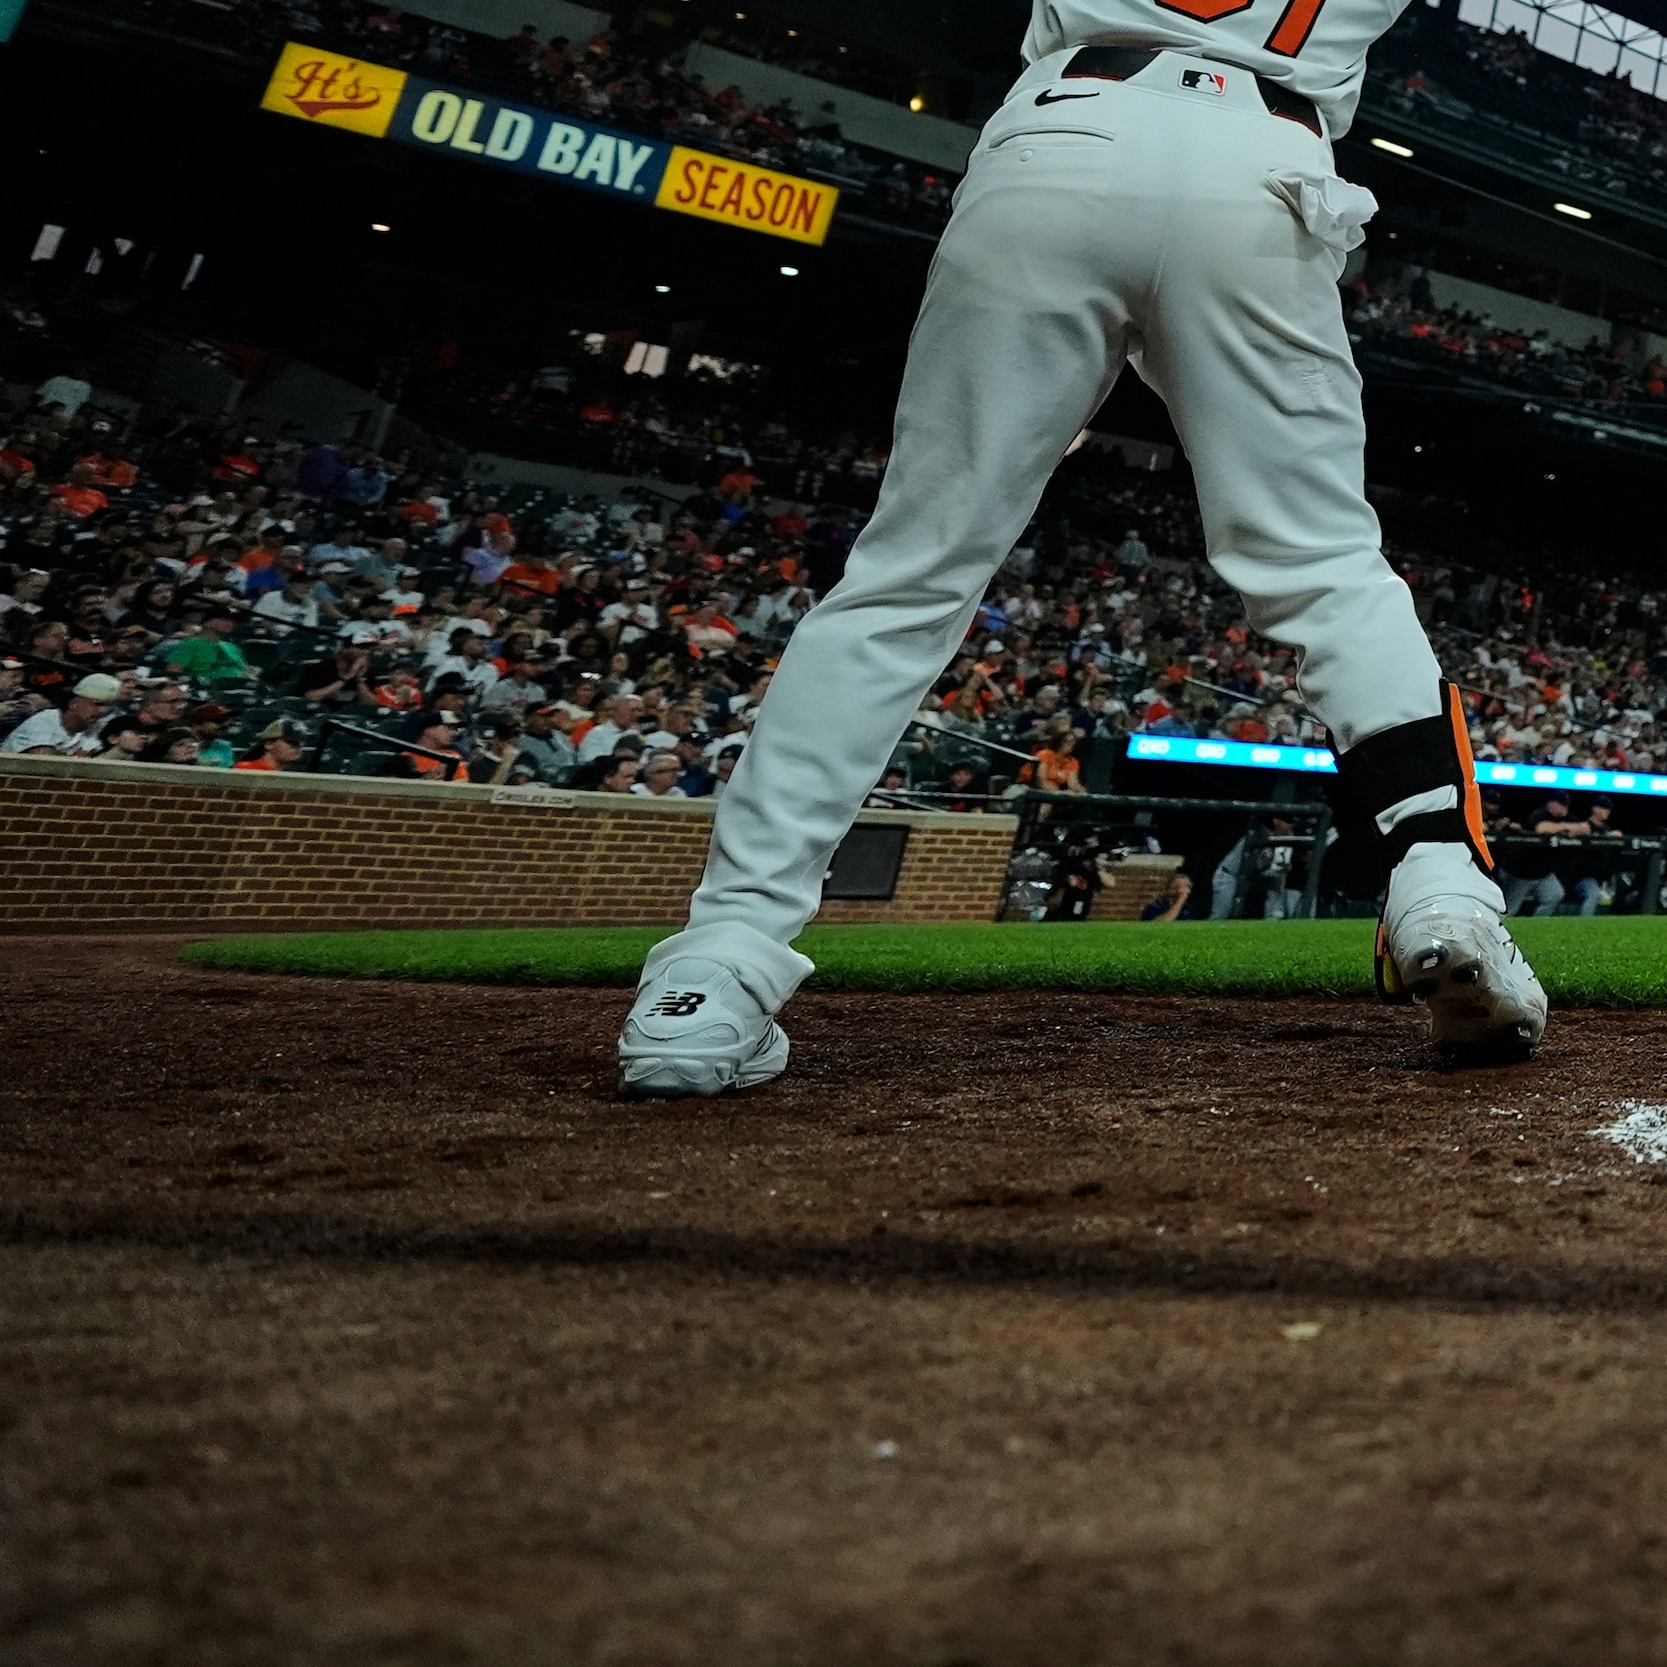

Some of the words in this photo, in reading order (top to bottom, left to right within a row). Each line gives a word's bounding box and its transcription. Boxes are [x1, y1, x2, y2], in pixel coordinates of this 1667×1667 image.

[288, 59, 372, 107] It's
[411, 89, 536, 163] OLD
[674, 160, 822, 234] SEASON
